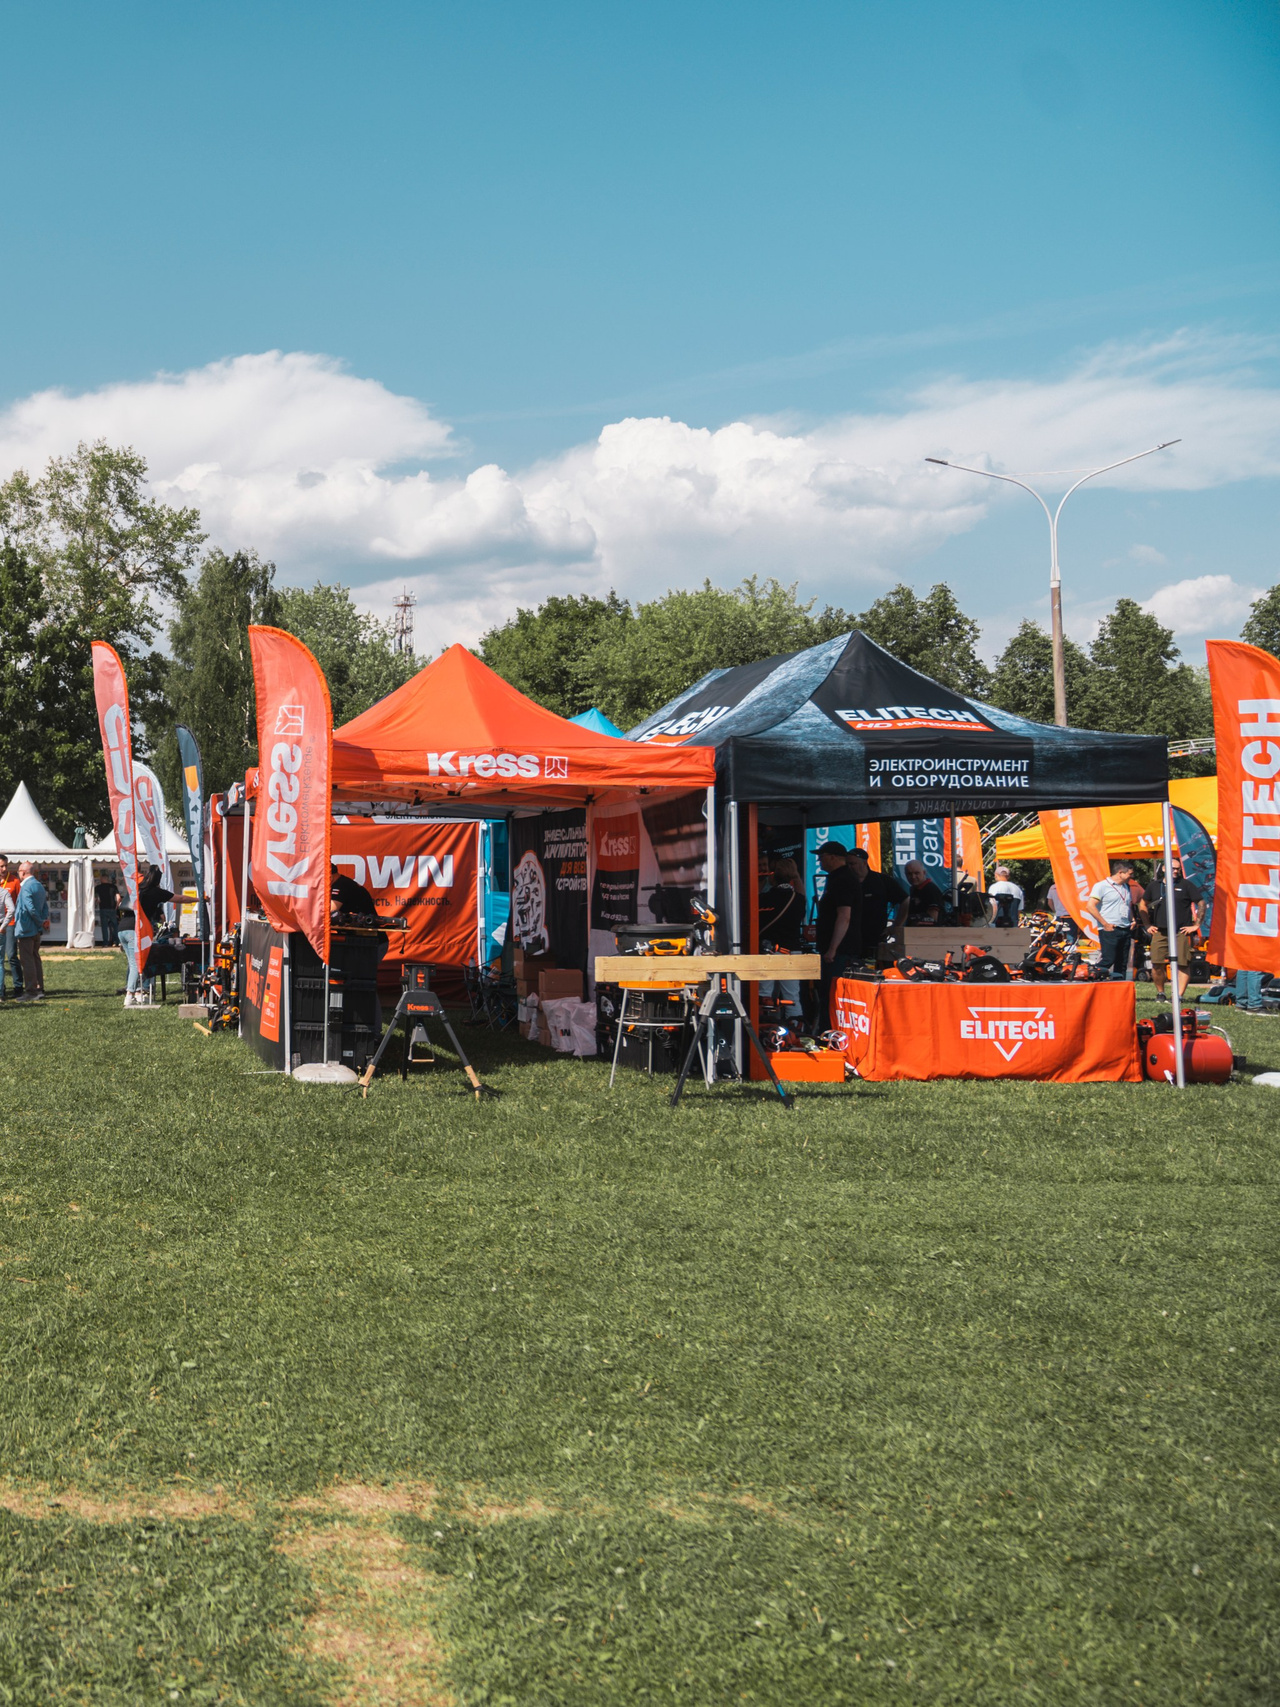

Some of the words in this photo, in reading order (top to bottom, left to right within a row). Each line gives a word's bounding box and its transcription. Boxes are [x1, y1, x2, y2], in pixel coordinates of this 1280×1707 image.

[834, 706, 981, 723] ELITECH
[897, 720, 988, 730] PROFESSIONAL
[426, 751, 540, 778] Kress
[869, 758, 1029, 772] ЭЛЕКТРОИНСТРУМЕНТ
[869, 775, 881, 788] И
[891, 775, 1029, 789] ОБОРУДОВАНИЕ
[1234, 698, 1280, 938] ELITECH
[331, 854, 454, 889] OWN
[406, 1003, 429, 1011] Kress
[960, 1019, 1055, 1040] ELITECH
